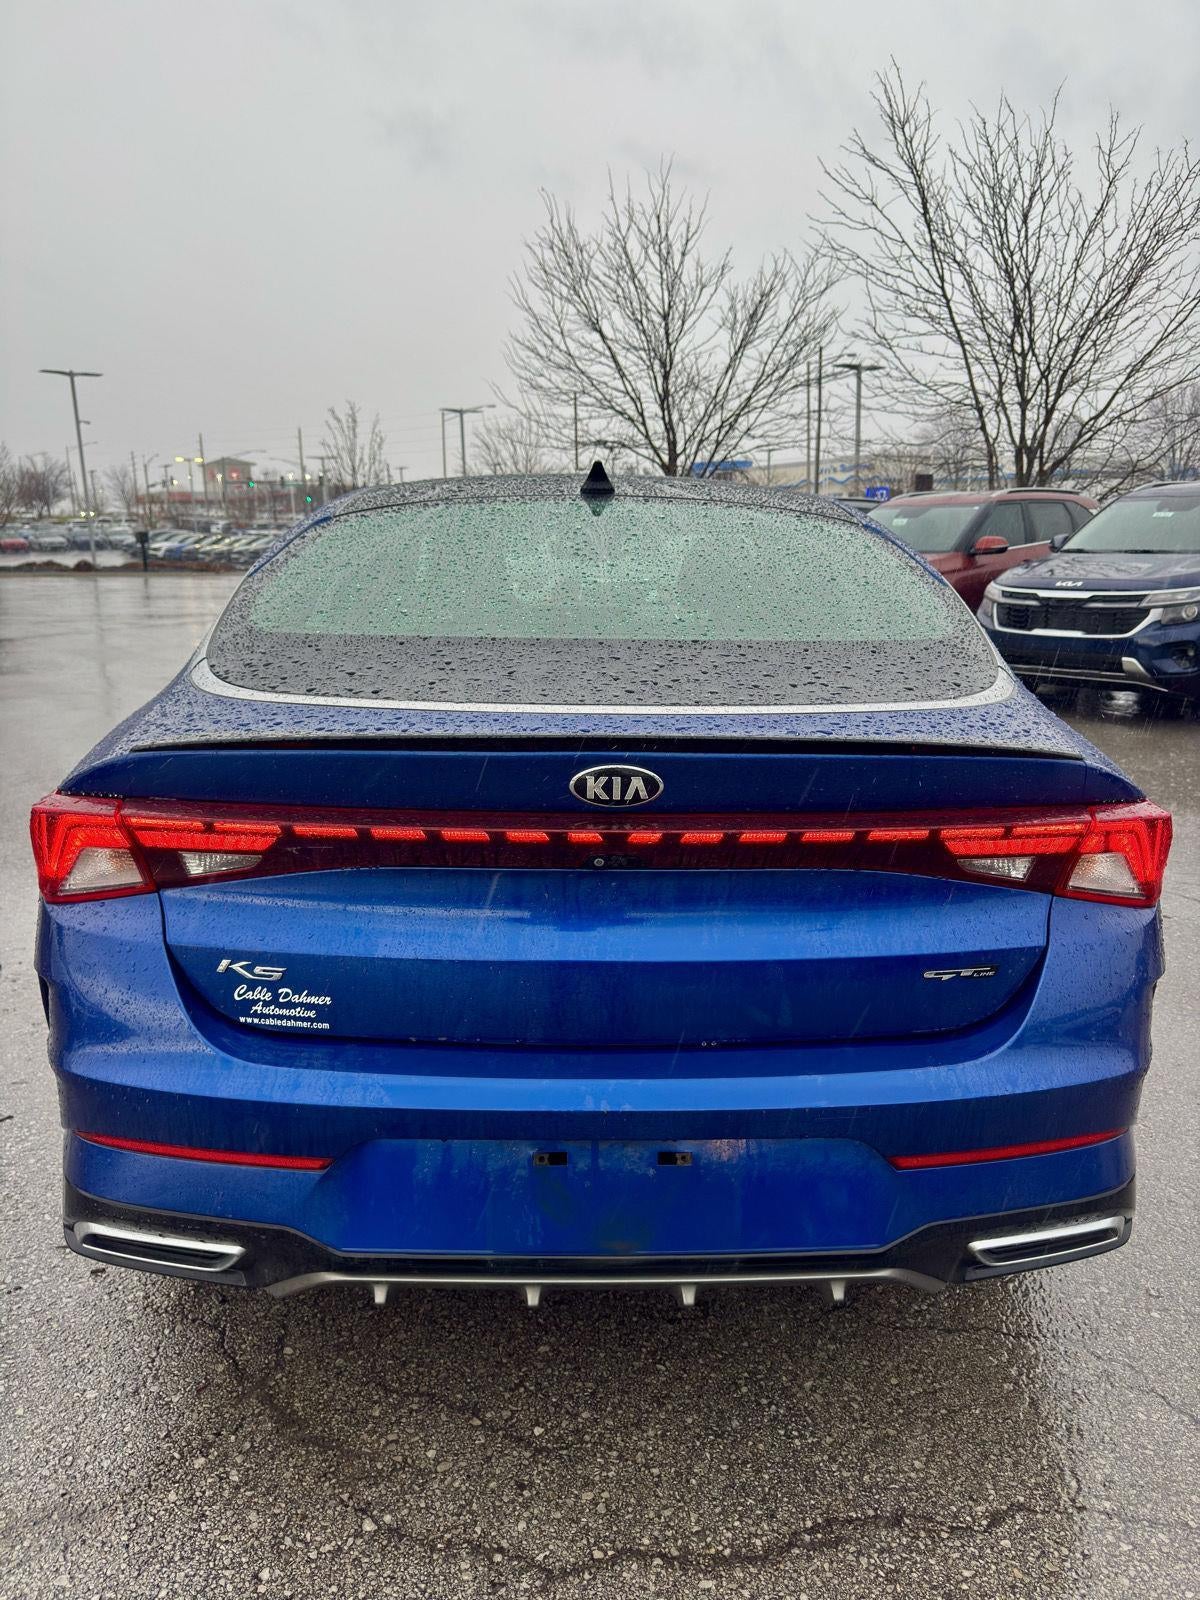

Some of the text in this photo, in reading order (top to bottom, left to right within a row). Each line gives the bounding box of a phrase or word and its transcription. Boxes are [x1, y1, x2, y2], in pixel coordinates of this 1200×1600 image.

[585, 775, 649, 800] KIA
[216, 959, 287, 981] K5
[923, 967, 991, 981] GT
[233, 984, 332, 1005] Cable Dahmer
[250, 1001, 317, 1018] Automotive
[239, 1016, 330, 1029] www.cabledahmer.com
